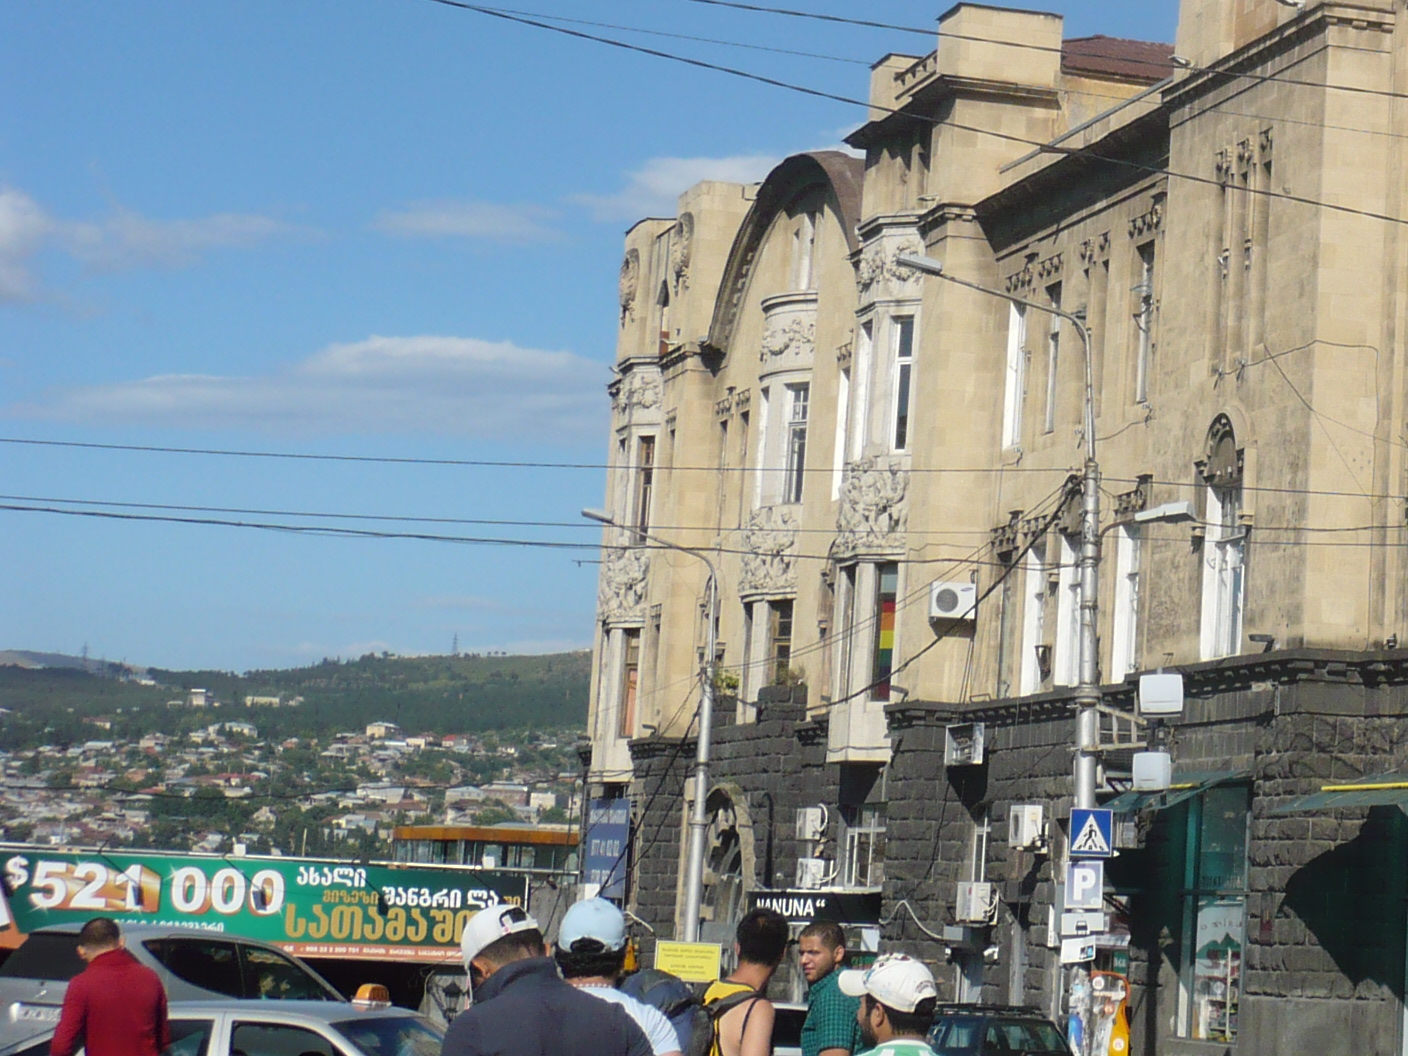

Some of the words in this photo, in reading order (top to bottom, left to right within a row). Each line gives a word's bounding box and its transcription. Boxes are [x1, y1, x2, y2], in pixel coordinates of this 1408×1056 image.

[171, 866, 285, 915] 000
[296, 866, 366, 888] ახალი
[1073, 867, 1097, 902] P
[322, 889, 379, 906] მიზეზი
[382, 886, 462, 909] შანგრი
[467, 889, 500, 908] ლა
